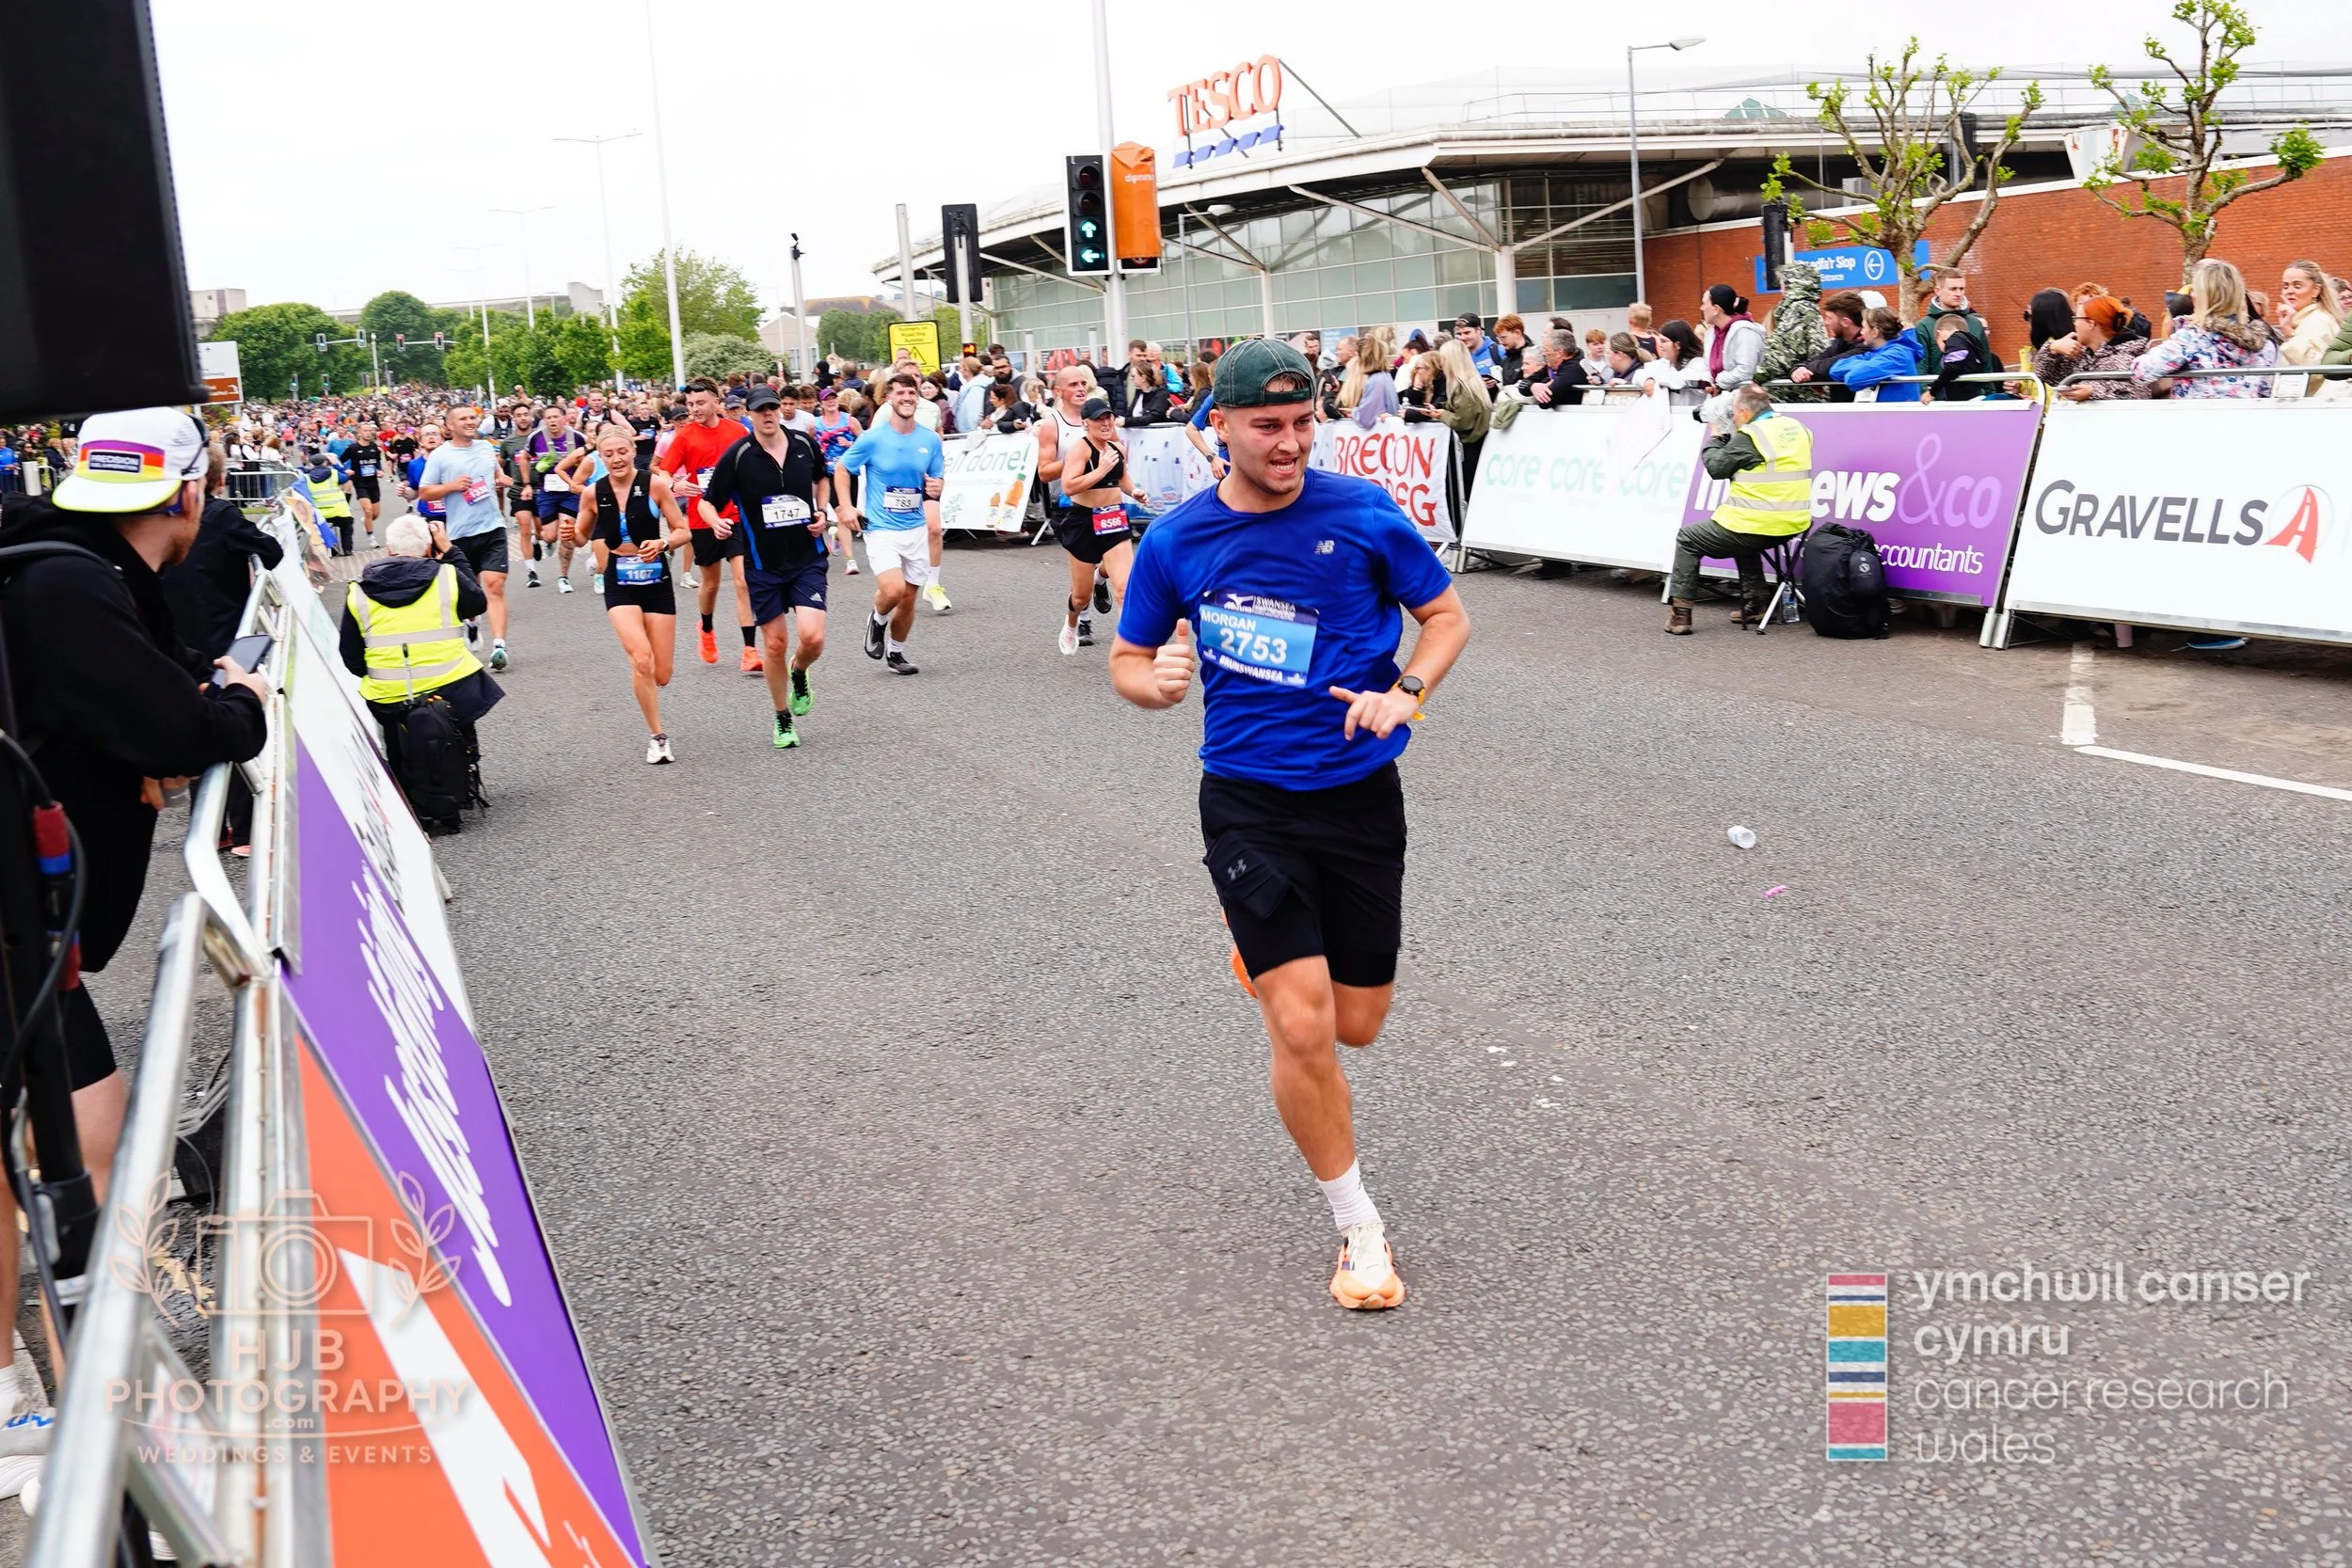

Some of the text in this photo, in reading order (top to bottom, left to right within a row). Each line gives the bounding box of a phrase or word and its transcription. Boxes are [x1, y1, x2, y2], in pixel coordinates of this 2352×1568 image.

[1168, 55, 1281, 136] TESCO
[966, 442, 1032, 472] done!
[1335, 433, 1436, 479] BRECON
[1486, 452, 1541, 488] core
[2035, 479, 2268, 546] GRAVELLS
[1875, 543, 1984, 575] ccountants
[1200, 609, 1257, 633] MORGAN
[1255, 595, 1296, 612] SWANSEA
[1219, 626, 1288, 664] 2753
